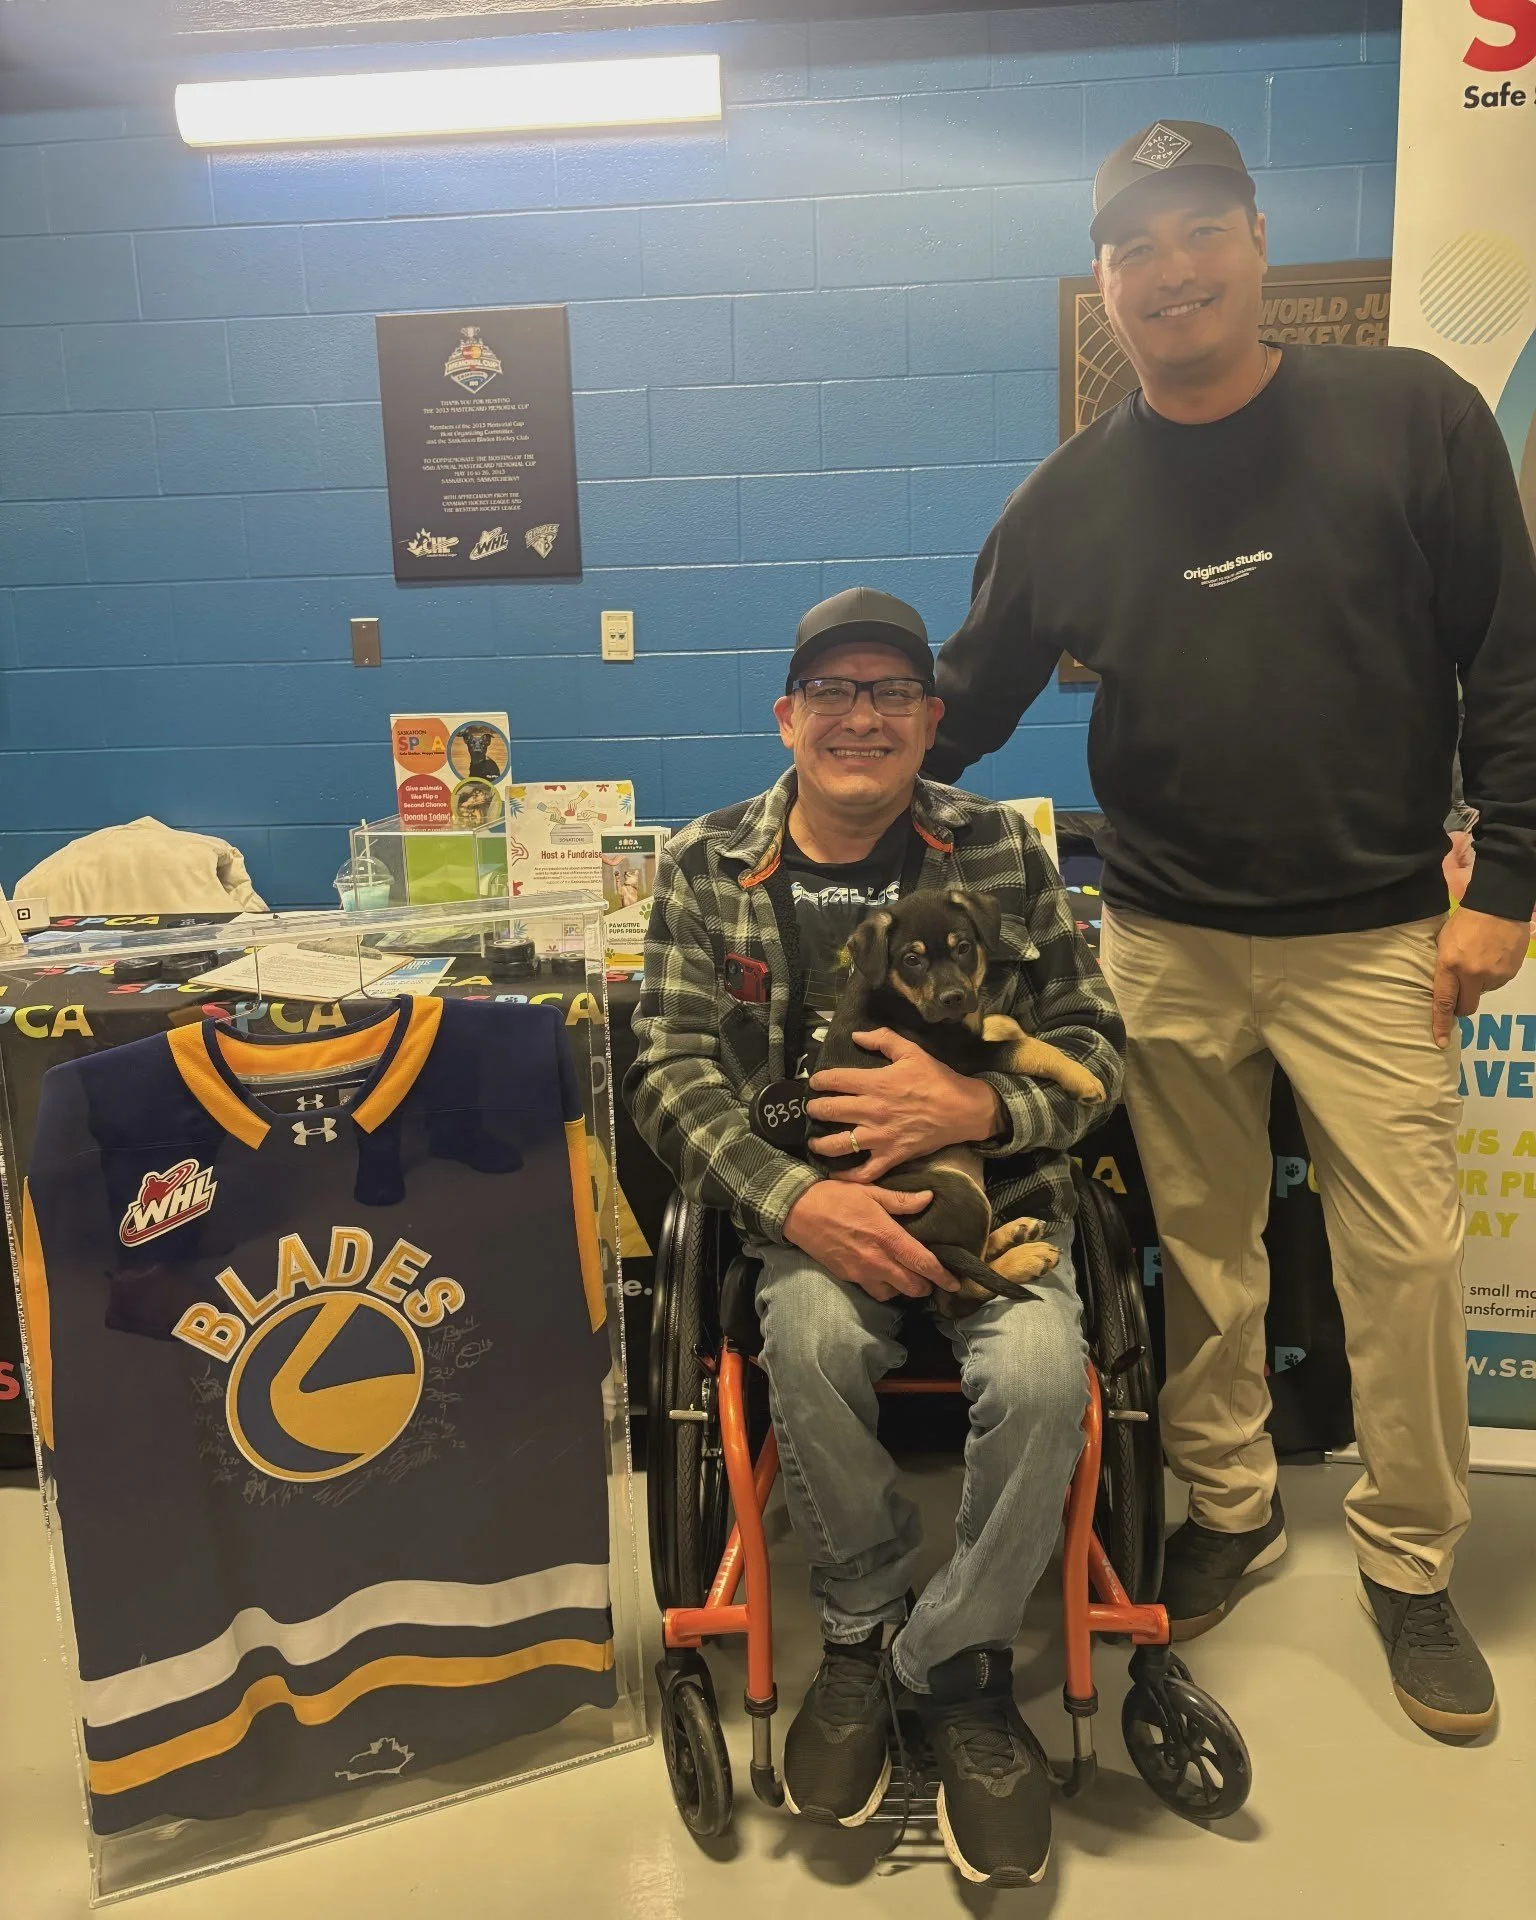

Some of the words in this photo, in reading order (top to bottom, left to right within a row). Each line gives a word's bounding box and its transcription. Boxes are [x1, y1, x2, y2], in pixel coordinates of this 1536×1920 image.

[1463, 81, 1526, 109] Safe
[1259, 296, 1348, 326] WORLD
[1259, 323, 1352, 345] OCKEY
[1183, 560, 1235, 580] Originals
[1235, 550, 1273, 567] Studio
[398, 736, 445, 751] SPCA
[541, 850, 558, 860] Host
[51, 916, 159, 927] SPCA
[763, 1098, 808, 1129] 835
[132, 1174, 211, 1232] WHL
[171, 1225, 466, 1363] BLADES
[1469, 1283, 1510, 1297] small
